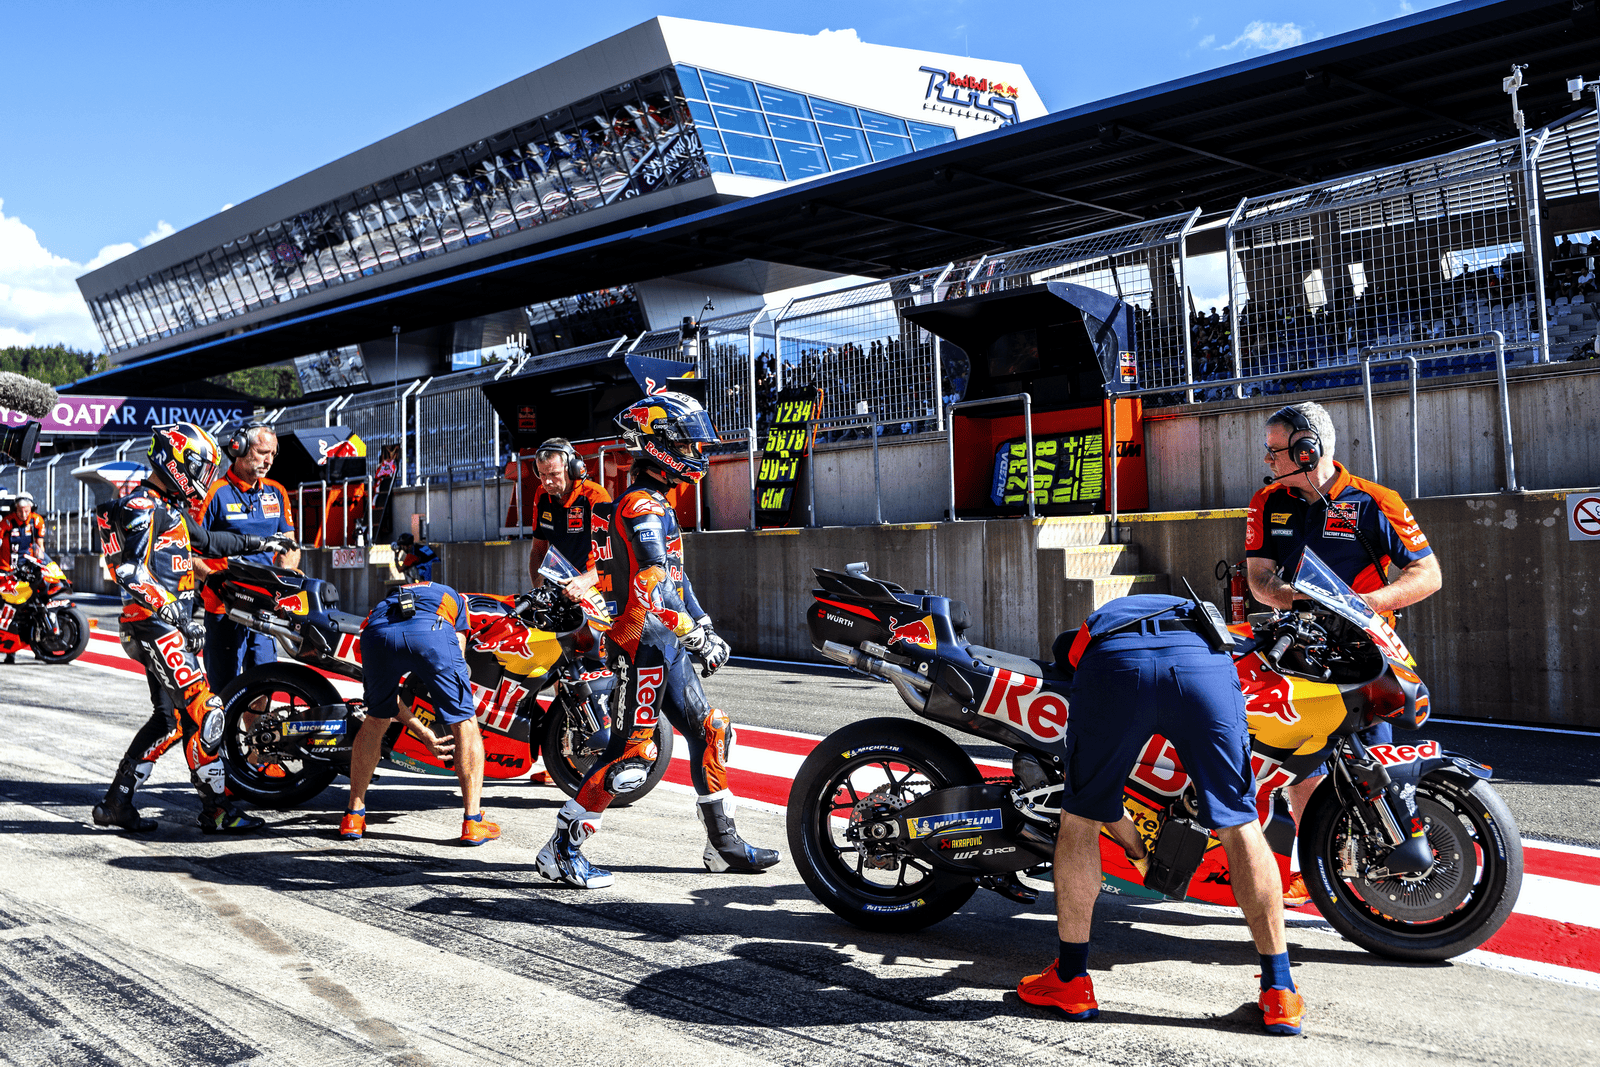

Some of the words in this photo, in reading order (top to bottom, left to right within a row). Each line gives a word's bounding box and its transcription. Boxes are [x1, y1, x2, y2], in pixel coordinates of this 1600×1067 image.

[949, 71, 969, 88] Red
[969, 76, 988, 91] Bull
[52, 403, 137, 426] QATAR
[144, 405, 243, 427] AIRWAYS
[645, 441, 666, 461] Red
[663, 452, 685, 472] Bull
[1108, 440, 1142, 458] KTM
[166, 459, 186, 481] Red
[178, 475, 196, 496] Bull
[154, 628, 204, 689] Red
[633, 665, 664, 727] Red
[980, 667, 1069, 741] Re
[299, 723, 341, 732] MICHELIN
[856, 745, 900, 754] MICHELIN
[1369, 740, 1437, 766] Red
[391, 758, 426, 774] MOTOREX
